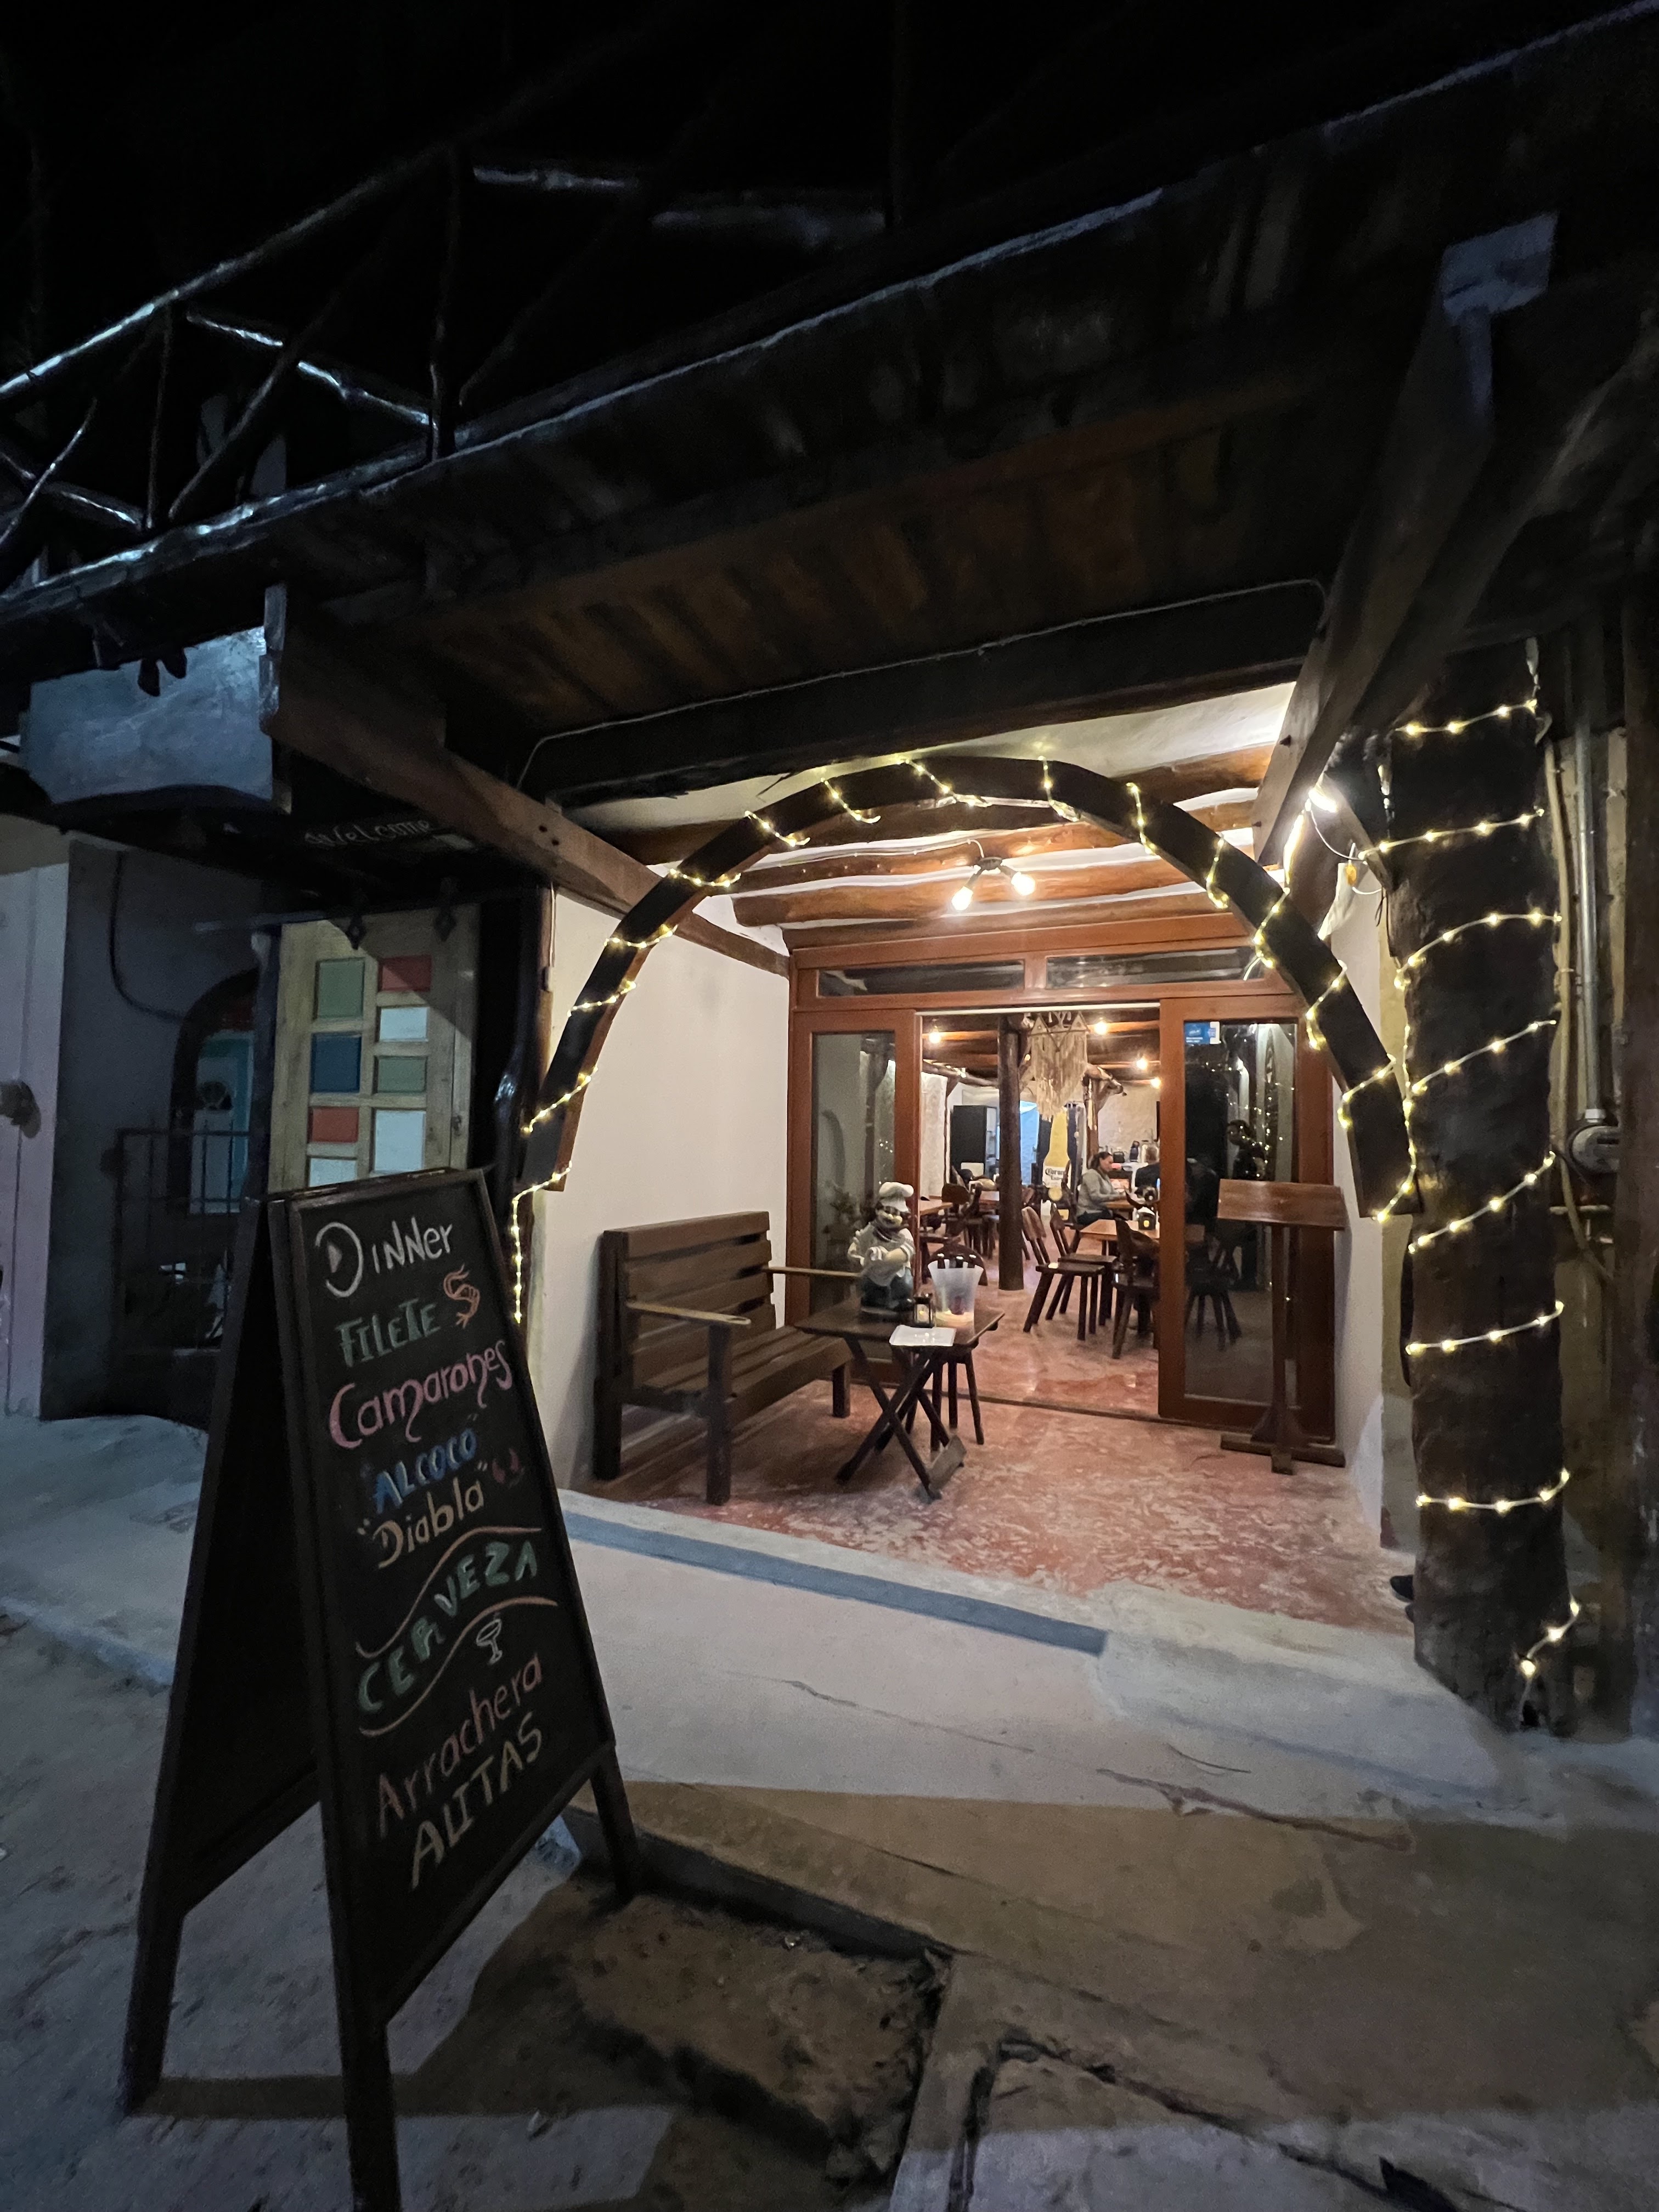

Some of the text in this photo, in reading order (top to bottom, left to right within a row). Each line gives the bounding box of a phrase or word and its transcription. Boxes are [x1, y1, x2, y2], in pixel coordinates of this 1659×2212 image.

[329, 1339, 513, 1449] Camarones
[358, 1540, 538, 1714] CERVEZA
[380, 1652, 543, 1840] Arrachera
[411, 1710, 543, 1892] ALITAS
